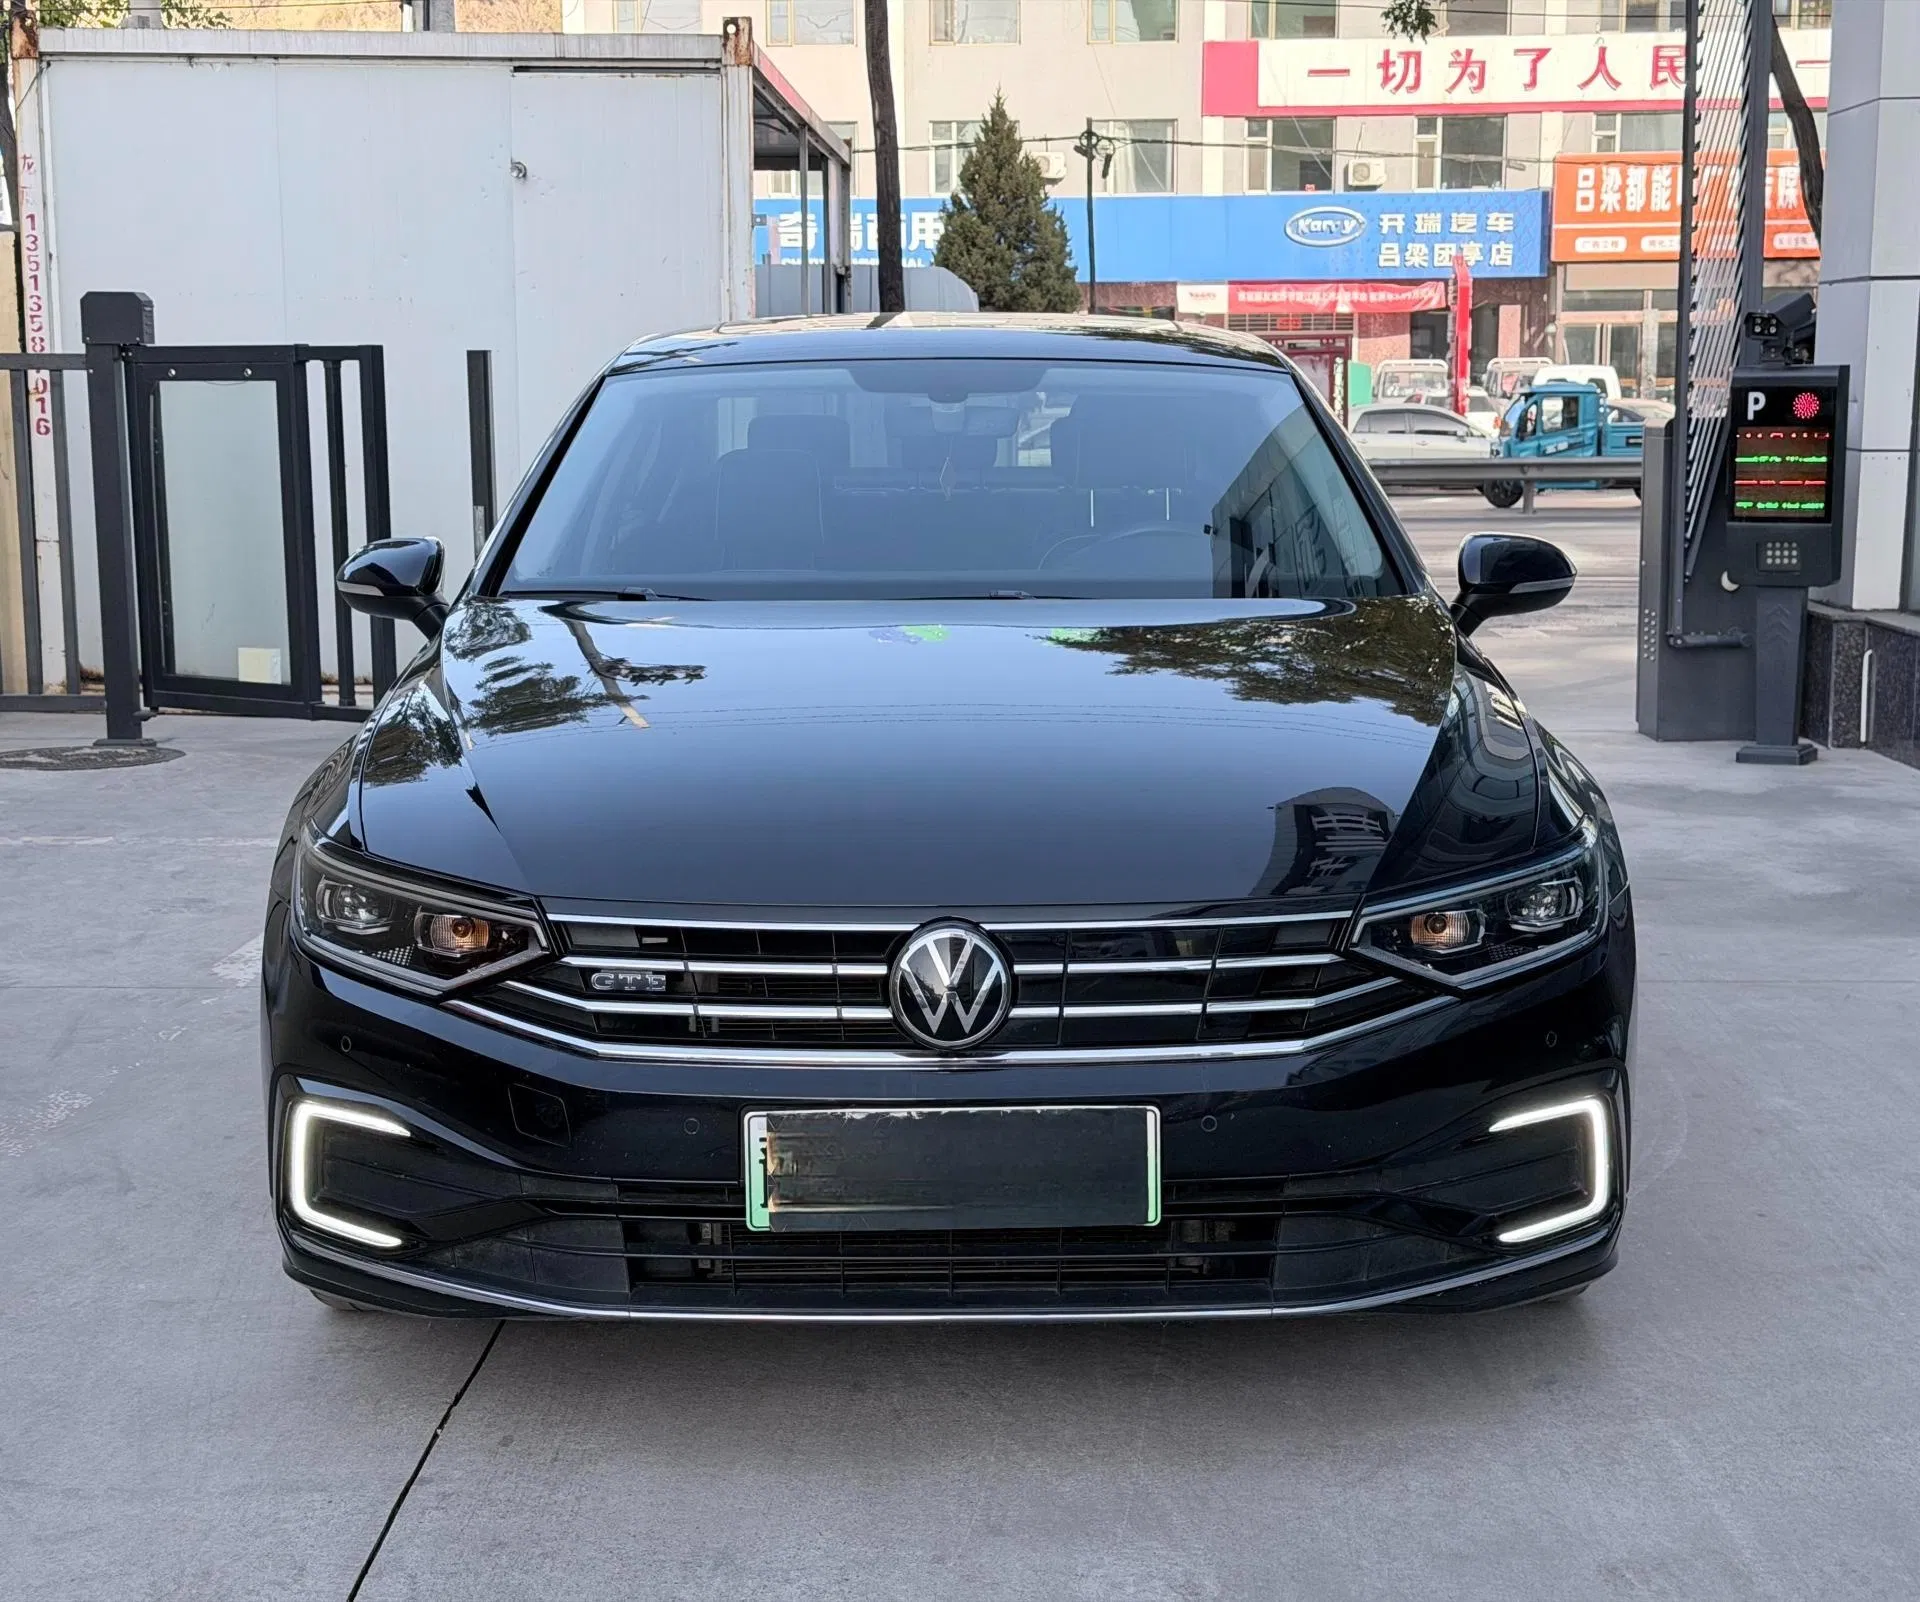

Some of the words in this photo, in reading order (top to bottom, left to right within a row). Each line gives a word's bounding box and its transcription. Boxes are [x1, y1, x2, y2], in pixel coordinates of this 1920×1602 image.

[1379, 212, 1514, 235] 开瑞汽车
[1747, 391, 1766, 421] P
[590, 971, 667, 992] GTE
